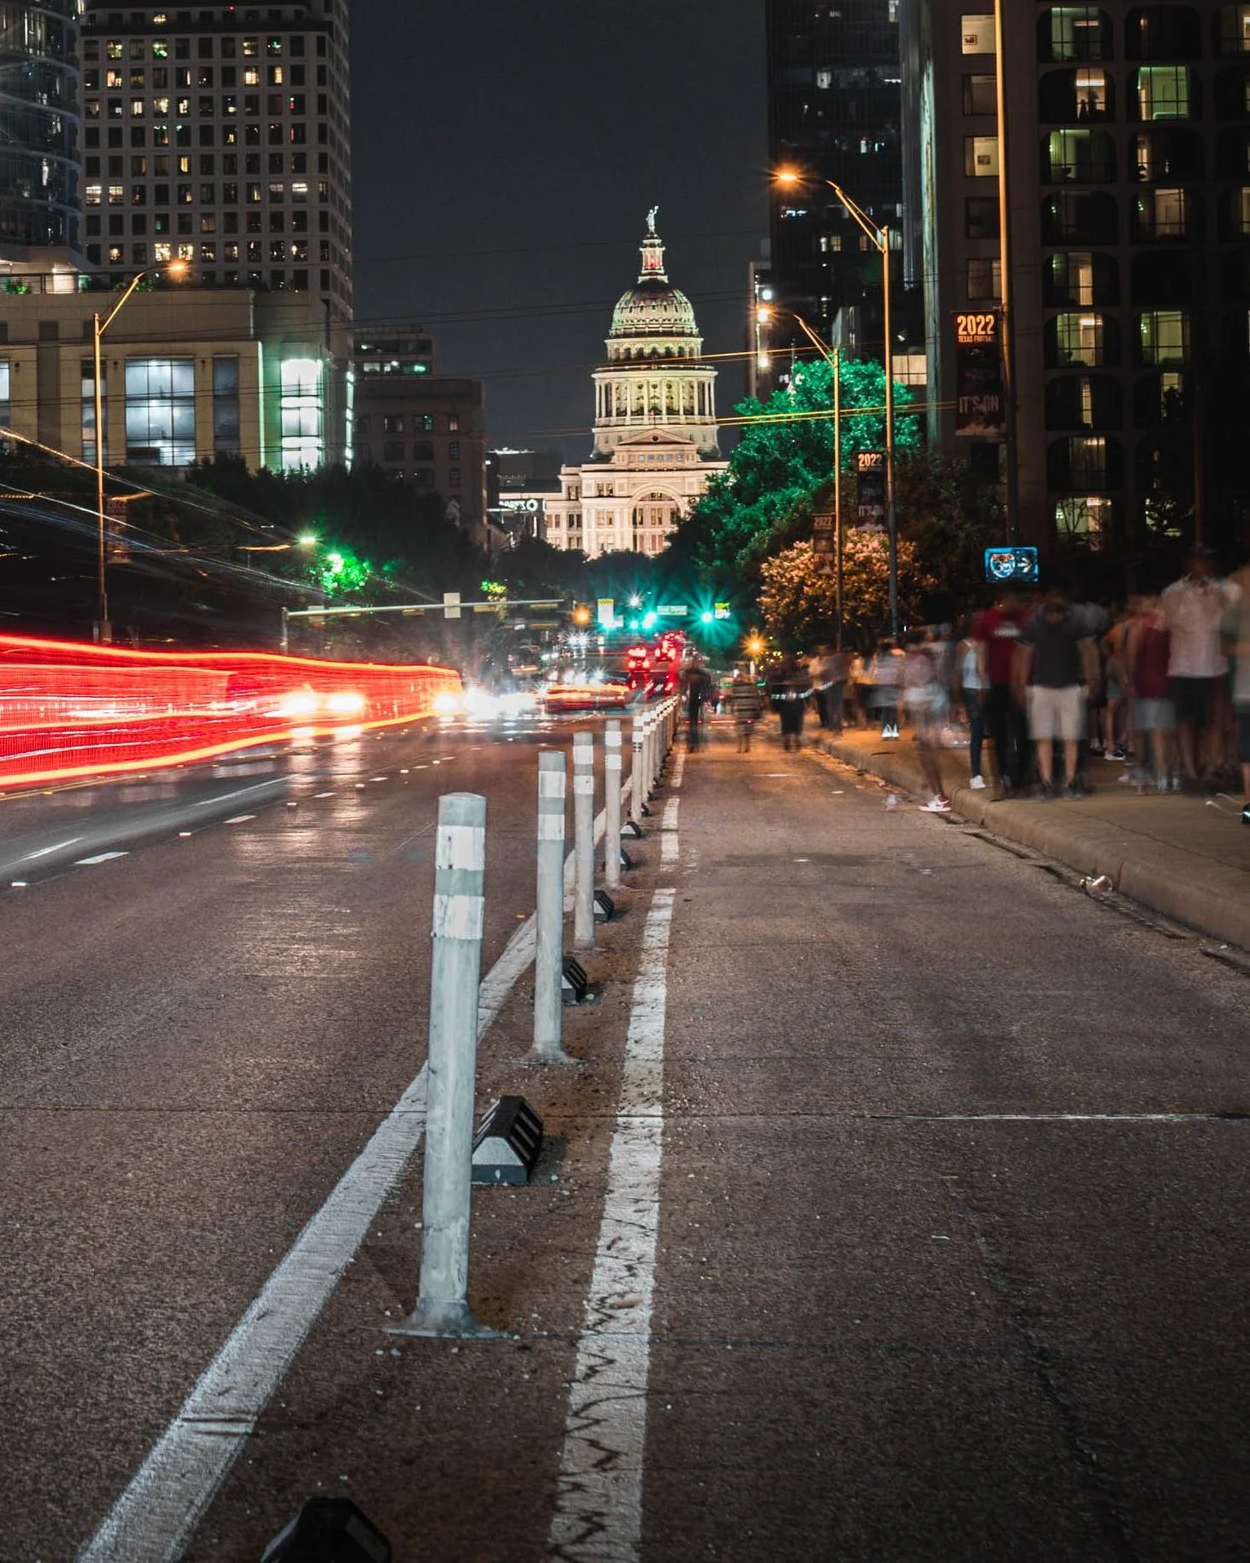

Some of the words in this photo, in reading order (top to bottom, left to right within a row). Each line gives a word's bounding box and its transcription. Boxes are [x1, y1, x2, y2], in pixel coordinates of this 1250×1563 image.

[957, 315, 995, 335] 2022
[858, 453, 883, 467] 2022
[813, 517, 833, 527] 2022
